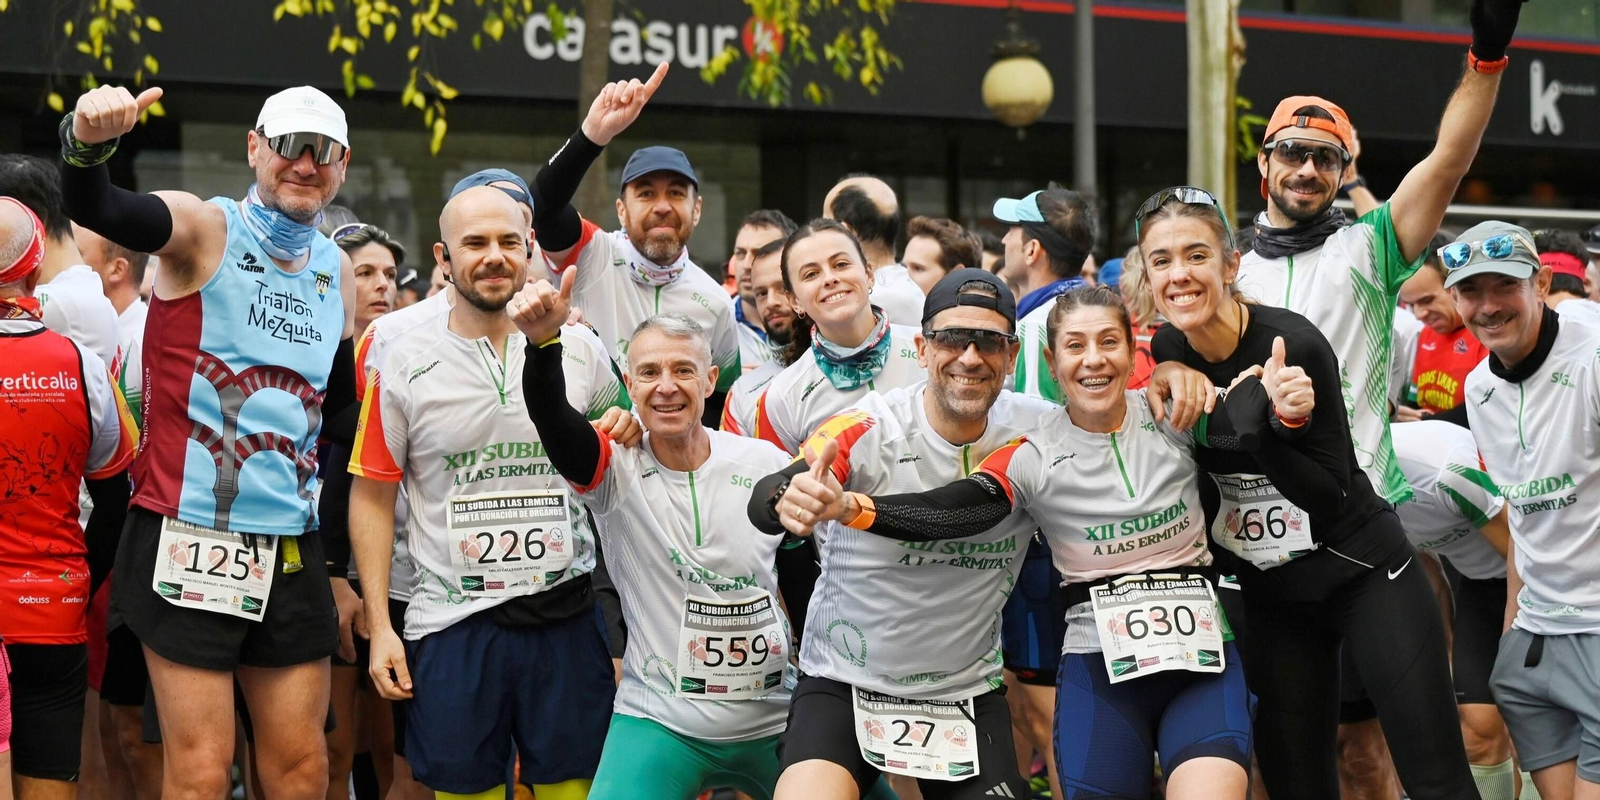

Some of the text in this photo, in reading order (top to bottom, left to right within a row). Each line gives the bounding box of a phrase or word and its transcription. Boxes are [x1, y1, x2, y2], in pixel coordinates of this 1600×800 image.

[523, 14, 738, 68] caasur
[236, 262, 265, 274] VIATOR
[690, 292, 709, 309] SIG
[0, 371, 79, 391] erticalia
[1550, 372, 1570, 387] SIG
[441, 449, 477, 472] XII
[453, 473, 462, 486] A
[466, 467, 495, 484] LAS
[730, 474, 753, 490] SIG
[1242, 480, 1258, 489] LAS
[1257, 488, 1267, 496] DE
[1512, 472, 1578, 500] SUBIDA
[453, 497, 560, 512] XII SUBIDA A LAS ERMITAS
[1523, 493, 1578, 516] ERMITAS
[454, 514, 470, 523] POR
[471, 513, 480, 522] LA
[520, 510, 529, 518] DE
[529, 507, 564, 517] ORGANOS
[1083, 498, 1188, 541] XII SUBIDA
[1093, 516, 1190, 555] A LAS ERMITAS
[477, 527, 546, 564] 226
[185, 541, 251, 580] 125
[898, 553, 1014, 571] A ERMITAS
[1149, 582, 1166, 590] LAS
[1166, 579, 1203, 589] ERMITAS
[19, 596, 50, 604] dobuss
[688, 601, 700, 611] XII
[700, 604, 732, 616] SUBIDA
[732, 606, 740, 615] A
[740, 604, 755, 615] LAS
[687, 614, 702, 624] POR
[702, 616, 712, 626] LA
[750, 616, 758, 625] DE
[1126, 606, 1196, 640] 630
[703, 634, 770, 668] 559
[874, 703, 884, 711] LA
[923, 705, 933, 713] DE
[892, 720, 936, 748] 27
